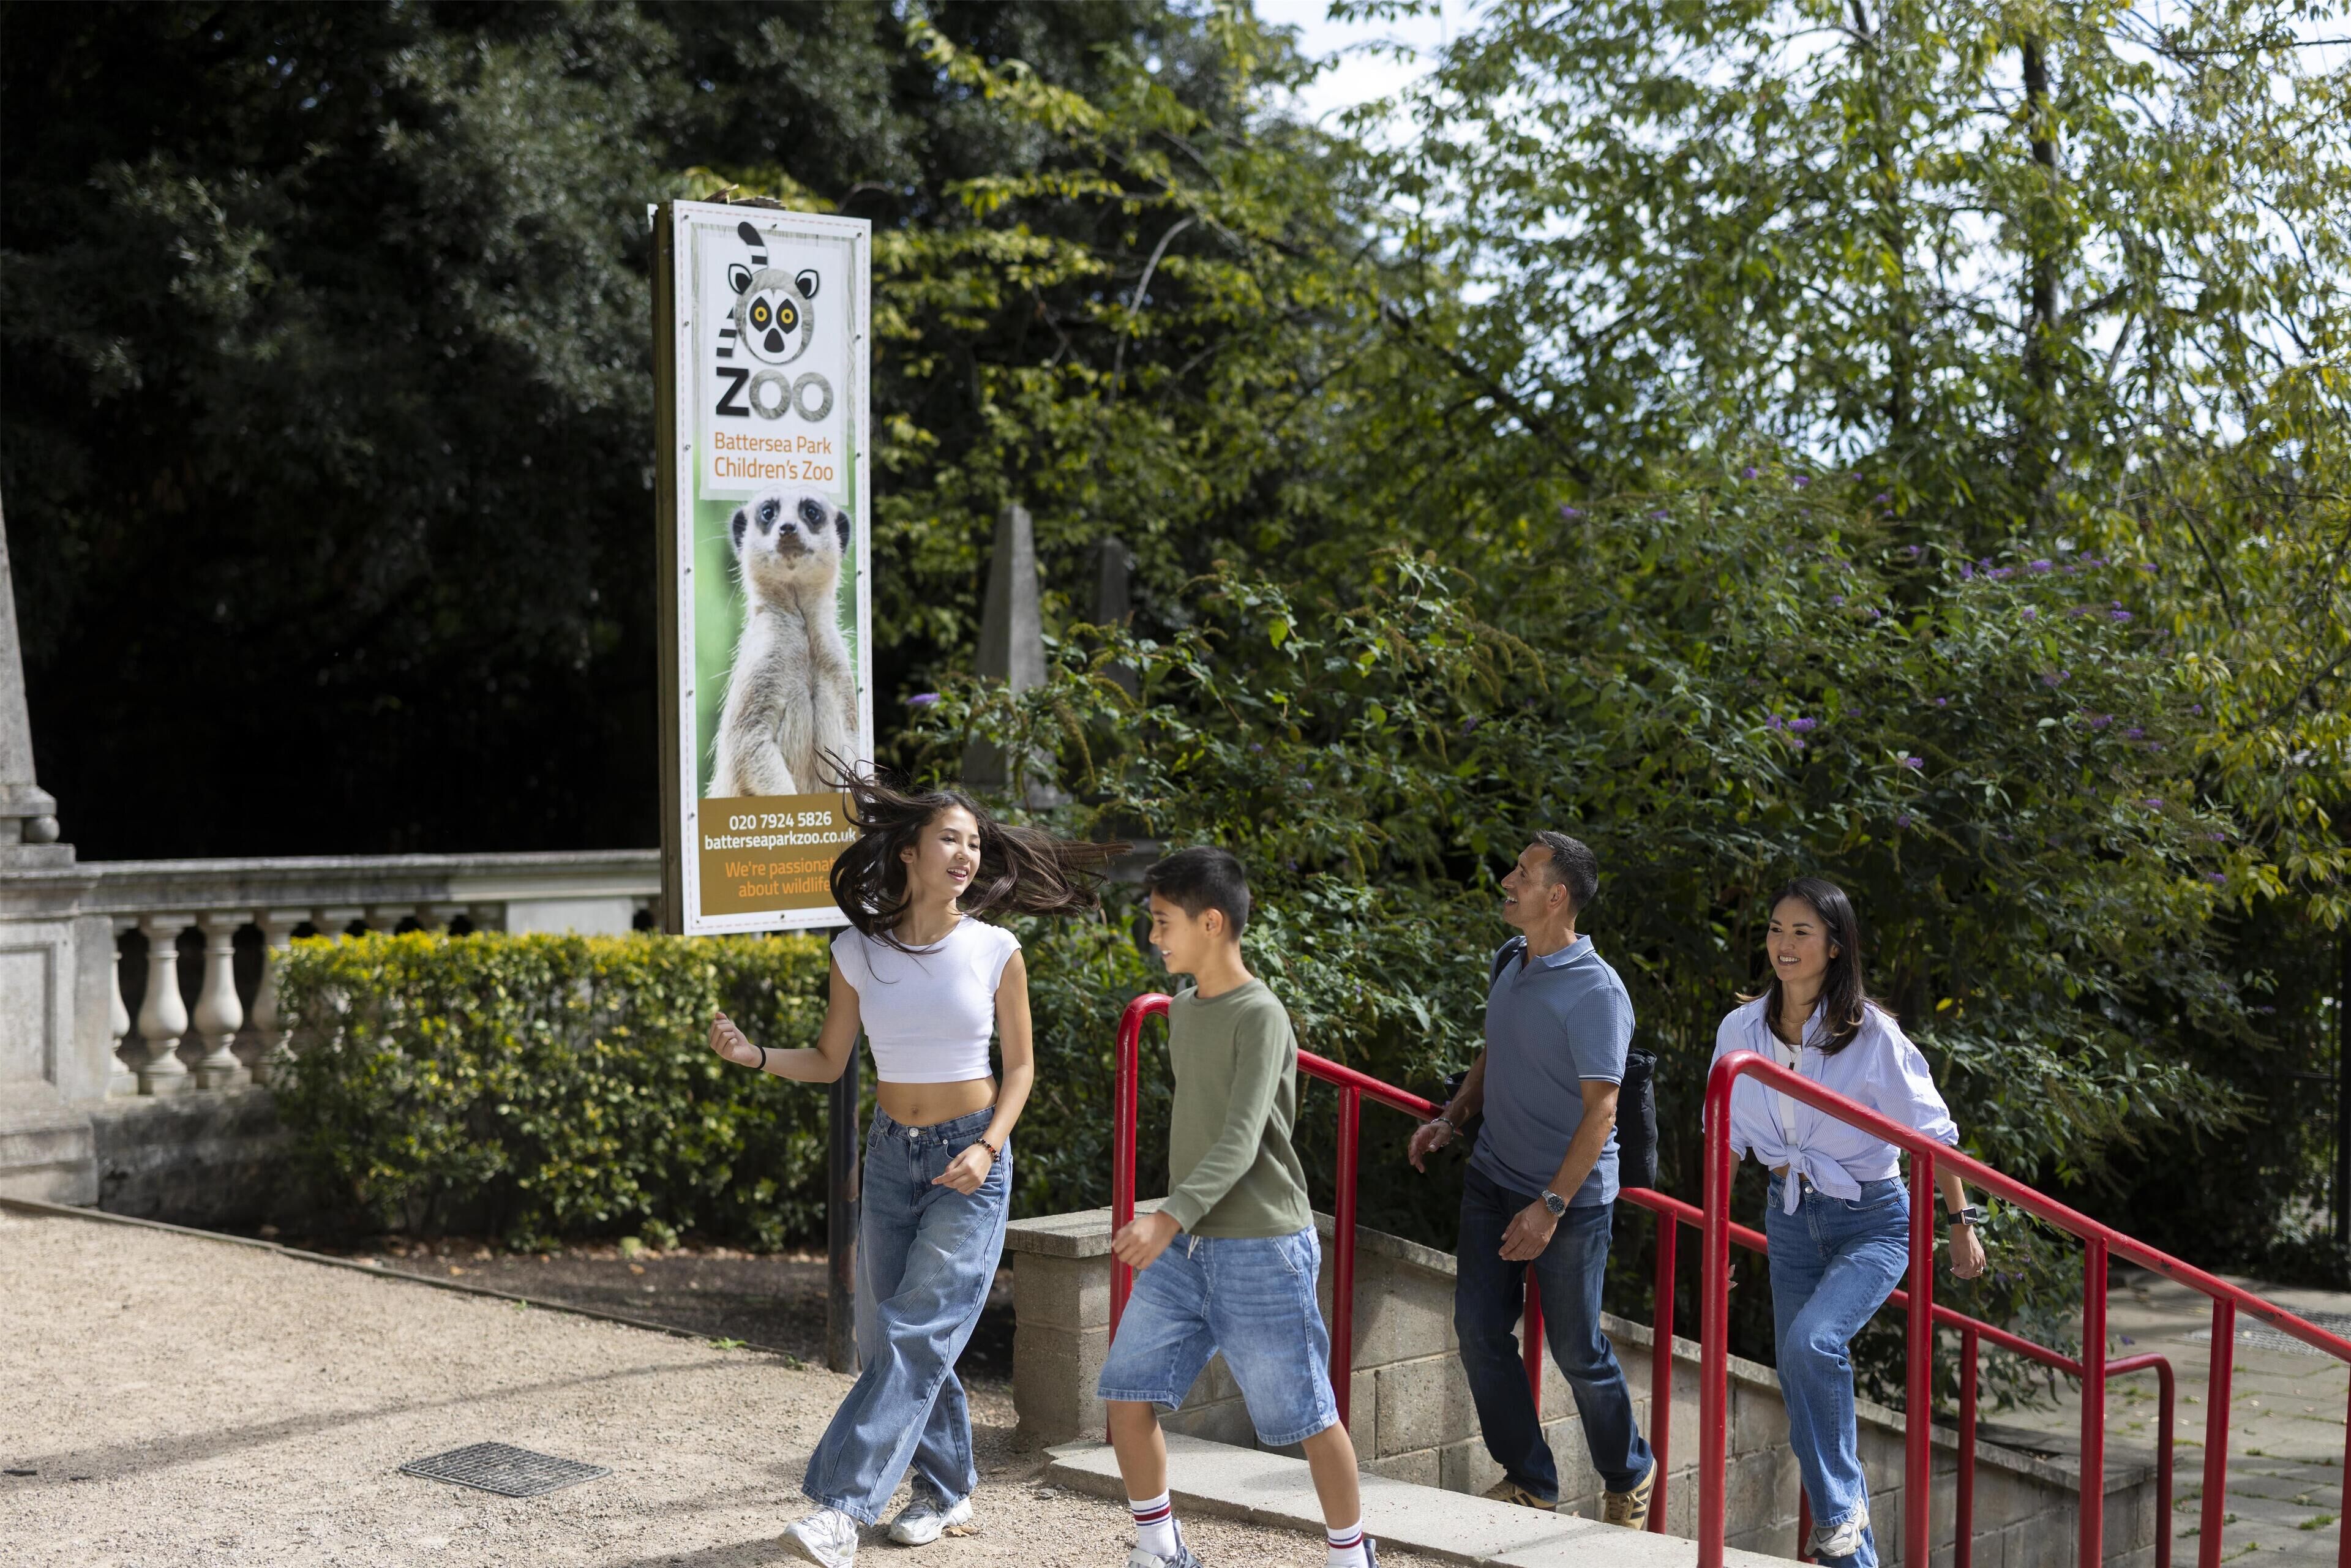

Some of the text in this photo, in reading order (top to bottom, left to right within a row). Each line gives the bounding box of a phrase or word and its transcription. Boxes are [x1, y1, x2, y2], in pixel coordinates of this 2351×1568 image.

[716, 367, 834, 422] ZOO
[714, 432, 831, 454] Battersea Park
[714, 457, 833, 481] Children's Zoo
[729, 811, 832, 831] 020 7924 5826
[705, 828, 856, 850] batterseaparkzoo.co.uk
[726, 857, 835, 879] We're passionat
[738, 876, 830, 898] about wildlife
